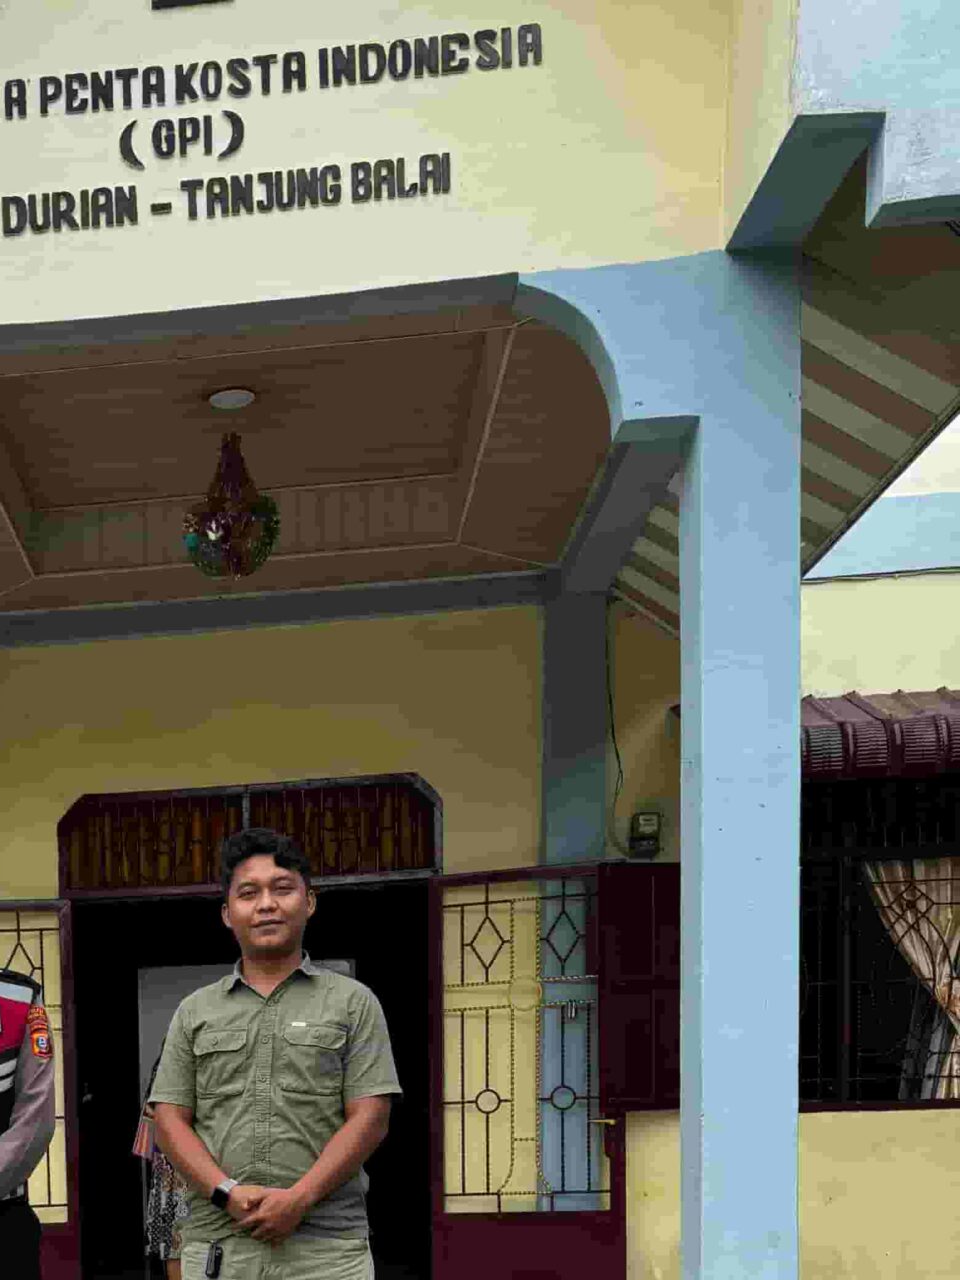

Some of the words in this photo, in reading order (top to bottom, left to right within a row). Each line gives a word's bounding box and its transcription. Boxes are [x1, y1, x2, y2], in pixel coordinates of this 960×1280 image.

[318, 23, 543, 89] INDONESIA
[1, 185, 138, 238] DURIAN
[180, 164, 342, 221] TANJUNG
[350, 152, 451, 204] BALAI
